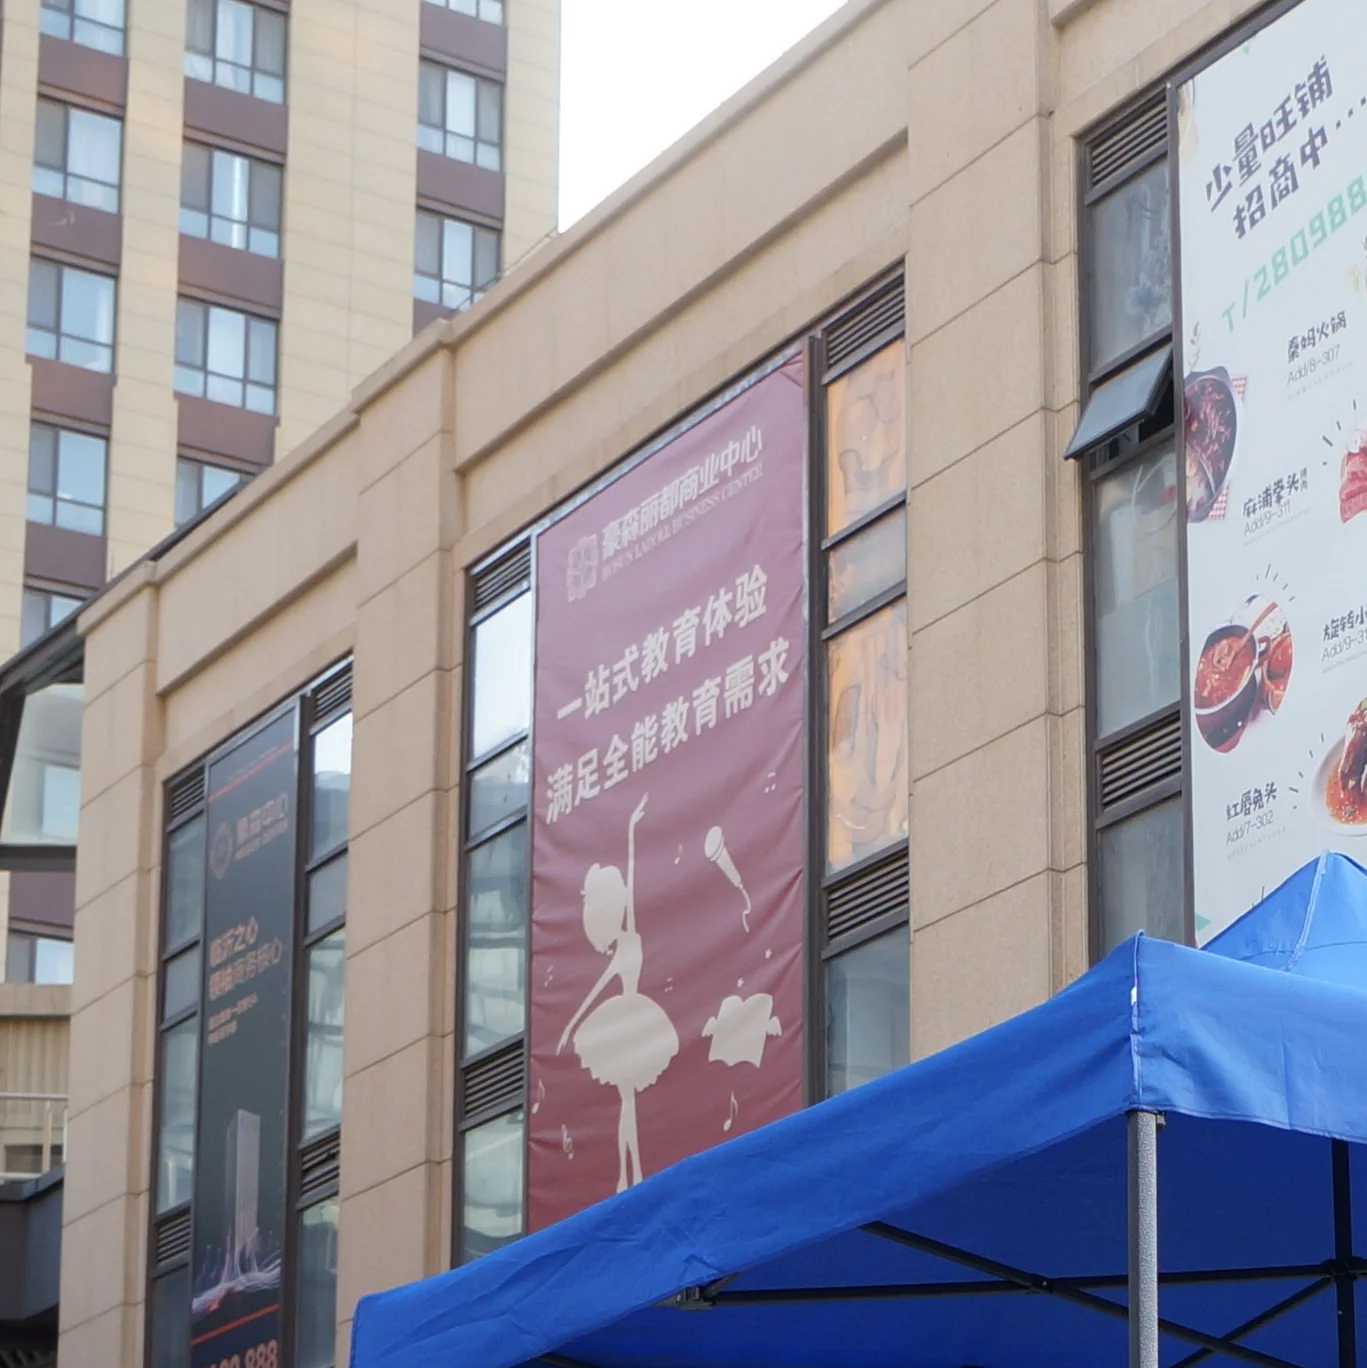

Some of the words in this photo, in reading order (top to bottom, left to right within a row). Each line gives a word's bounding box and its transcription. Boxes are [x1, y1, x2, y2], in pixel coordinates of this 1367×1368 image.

[1206, 54, 1334, 213] 少量旺铺
[1288, 310, 1347, 364] 秦妈火锅
[601, 425, 764, 562] 豪森丽都商业中心
[557, 564, 768, 721] 一站式教育体验
[546, 637, 789, 825] 满足全能教育需求
